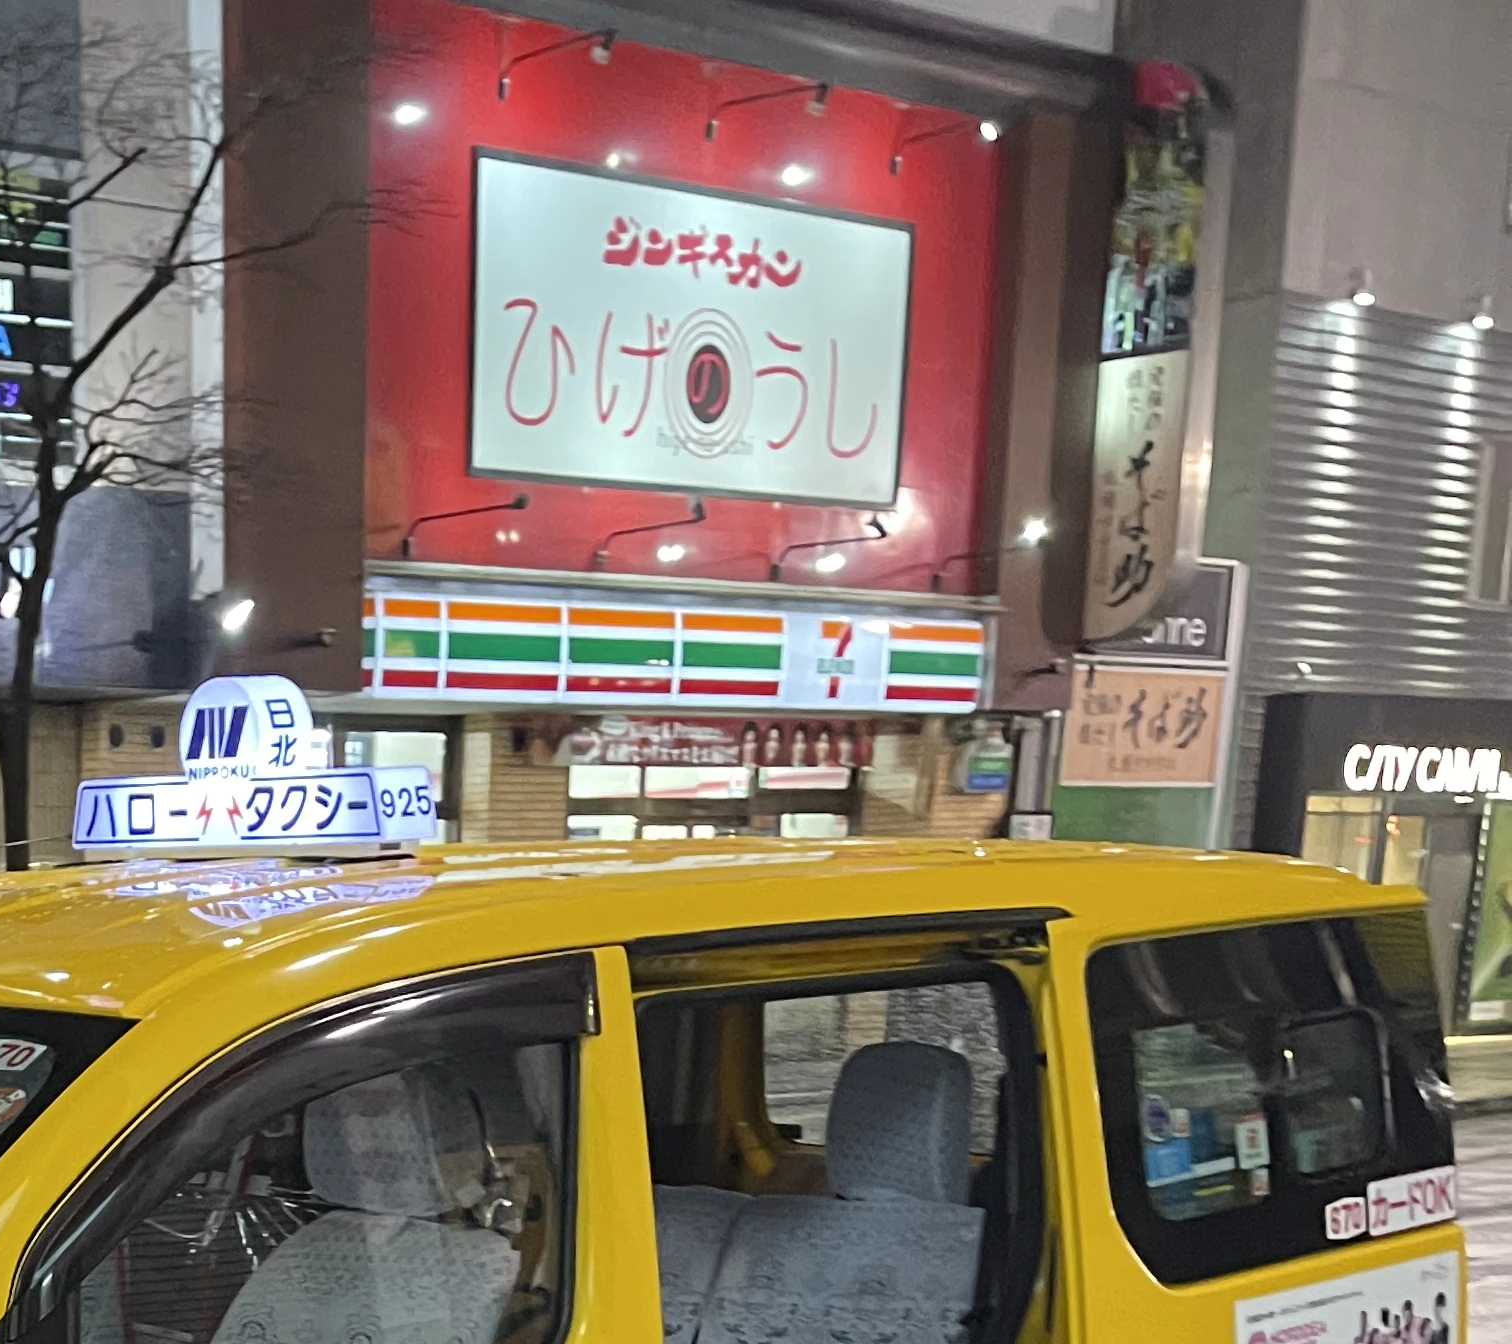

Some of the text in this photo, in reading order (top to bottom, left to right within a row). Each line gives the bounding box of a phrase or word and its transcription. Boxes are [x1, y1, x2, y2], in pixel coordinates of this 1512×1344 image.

[603, 216, 802, 288] ジンギスカン
[504, 297, 877, 460] ひげのうし
[1343, 743, 1419, 791] CITY
[86, 785, 369, 838] ハロー タクシー
[380, 786, 432, 818] 925
[1372, 1175, 1454, 1229] カードOK
